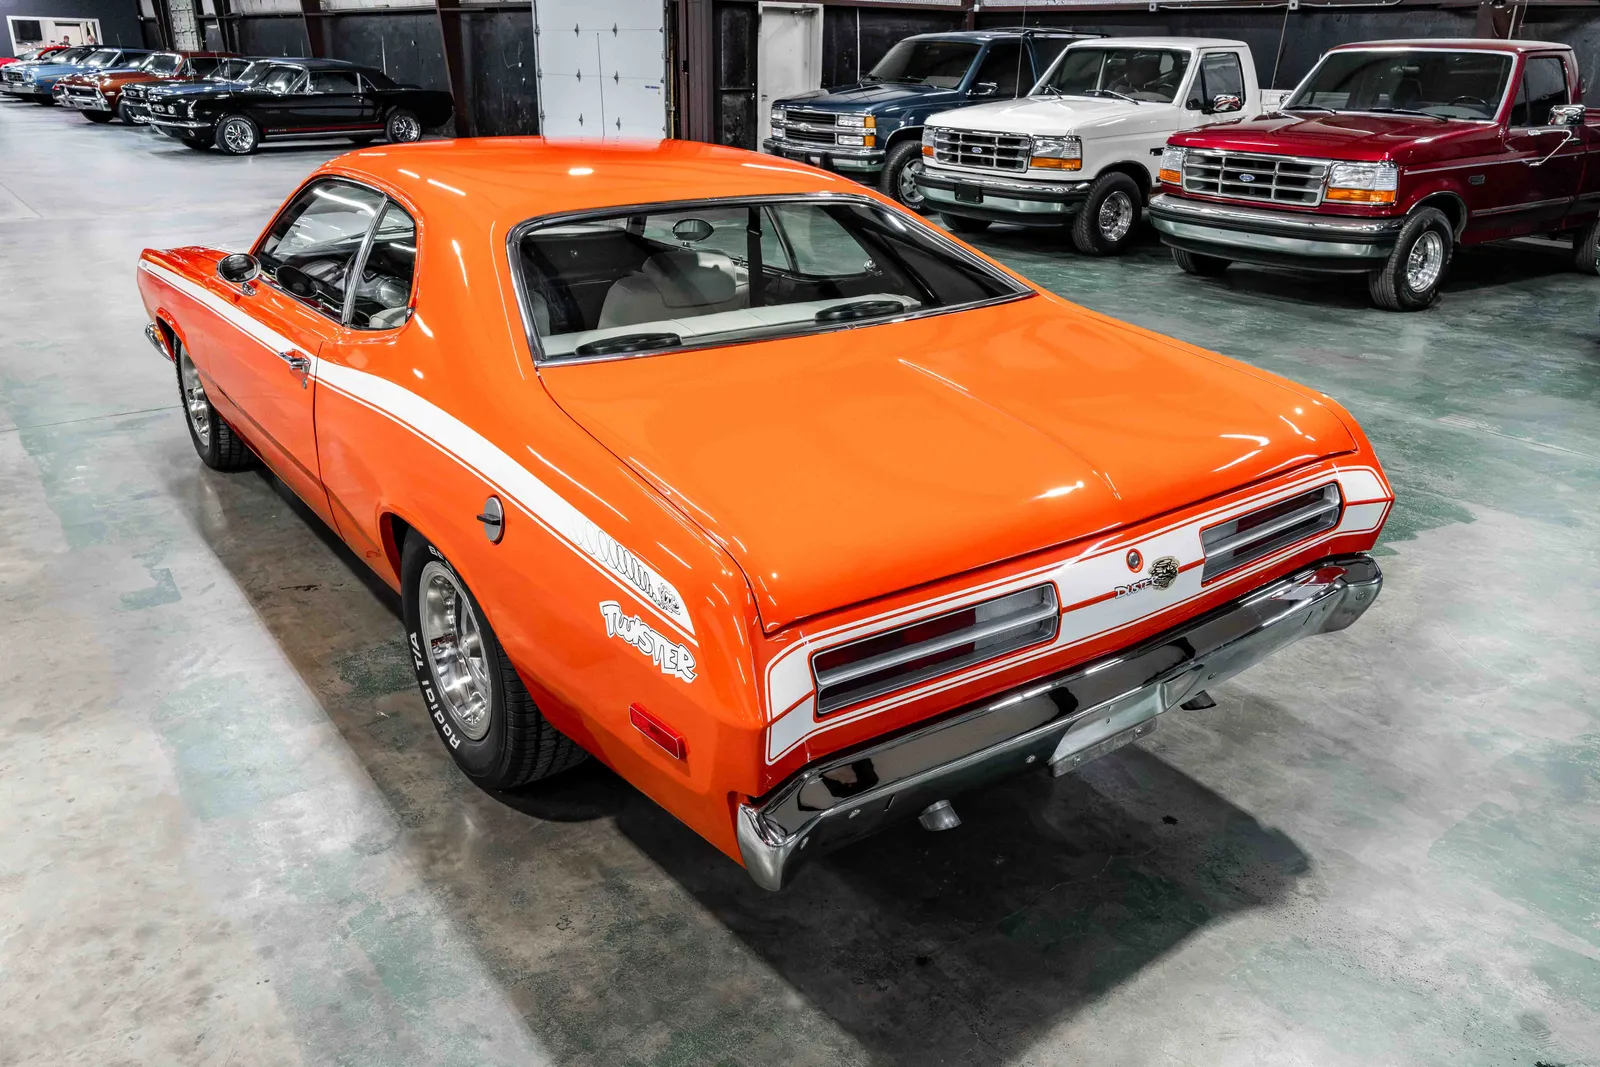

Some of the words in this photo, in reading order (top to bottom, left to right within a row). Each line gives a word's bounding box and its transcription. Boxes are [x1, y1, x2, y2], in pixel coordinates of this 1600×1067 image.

[1114, 575, 1160, 599] DUSTER
[409, 632, 424, 670] T/A
[600, 601, 698, 682] TWISTER
[422, 680, 461, 750] Radial
